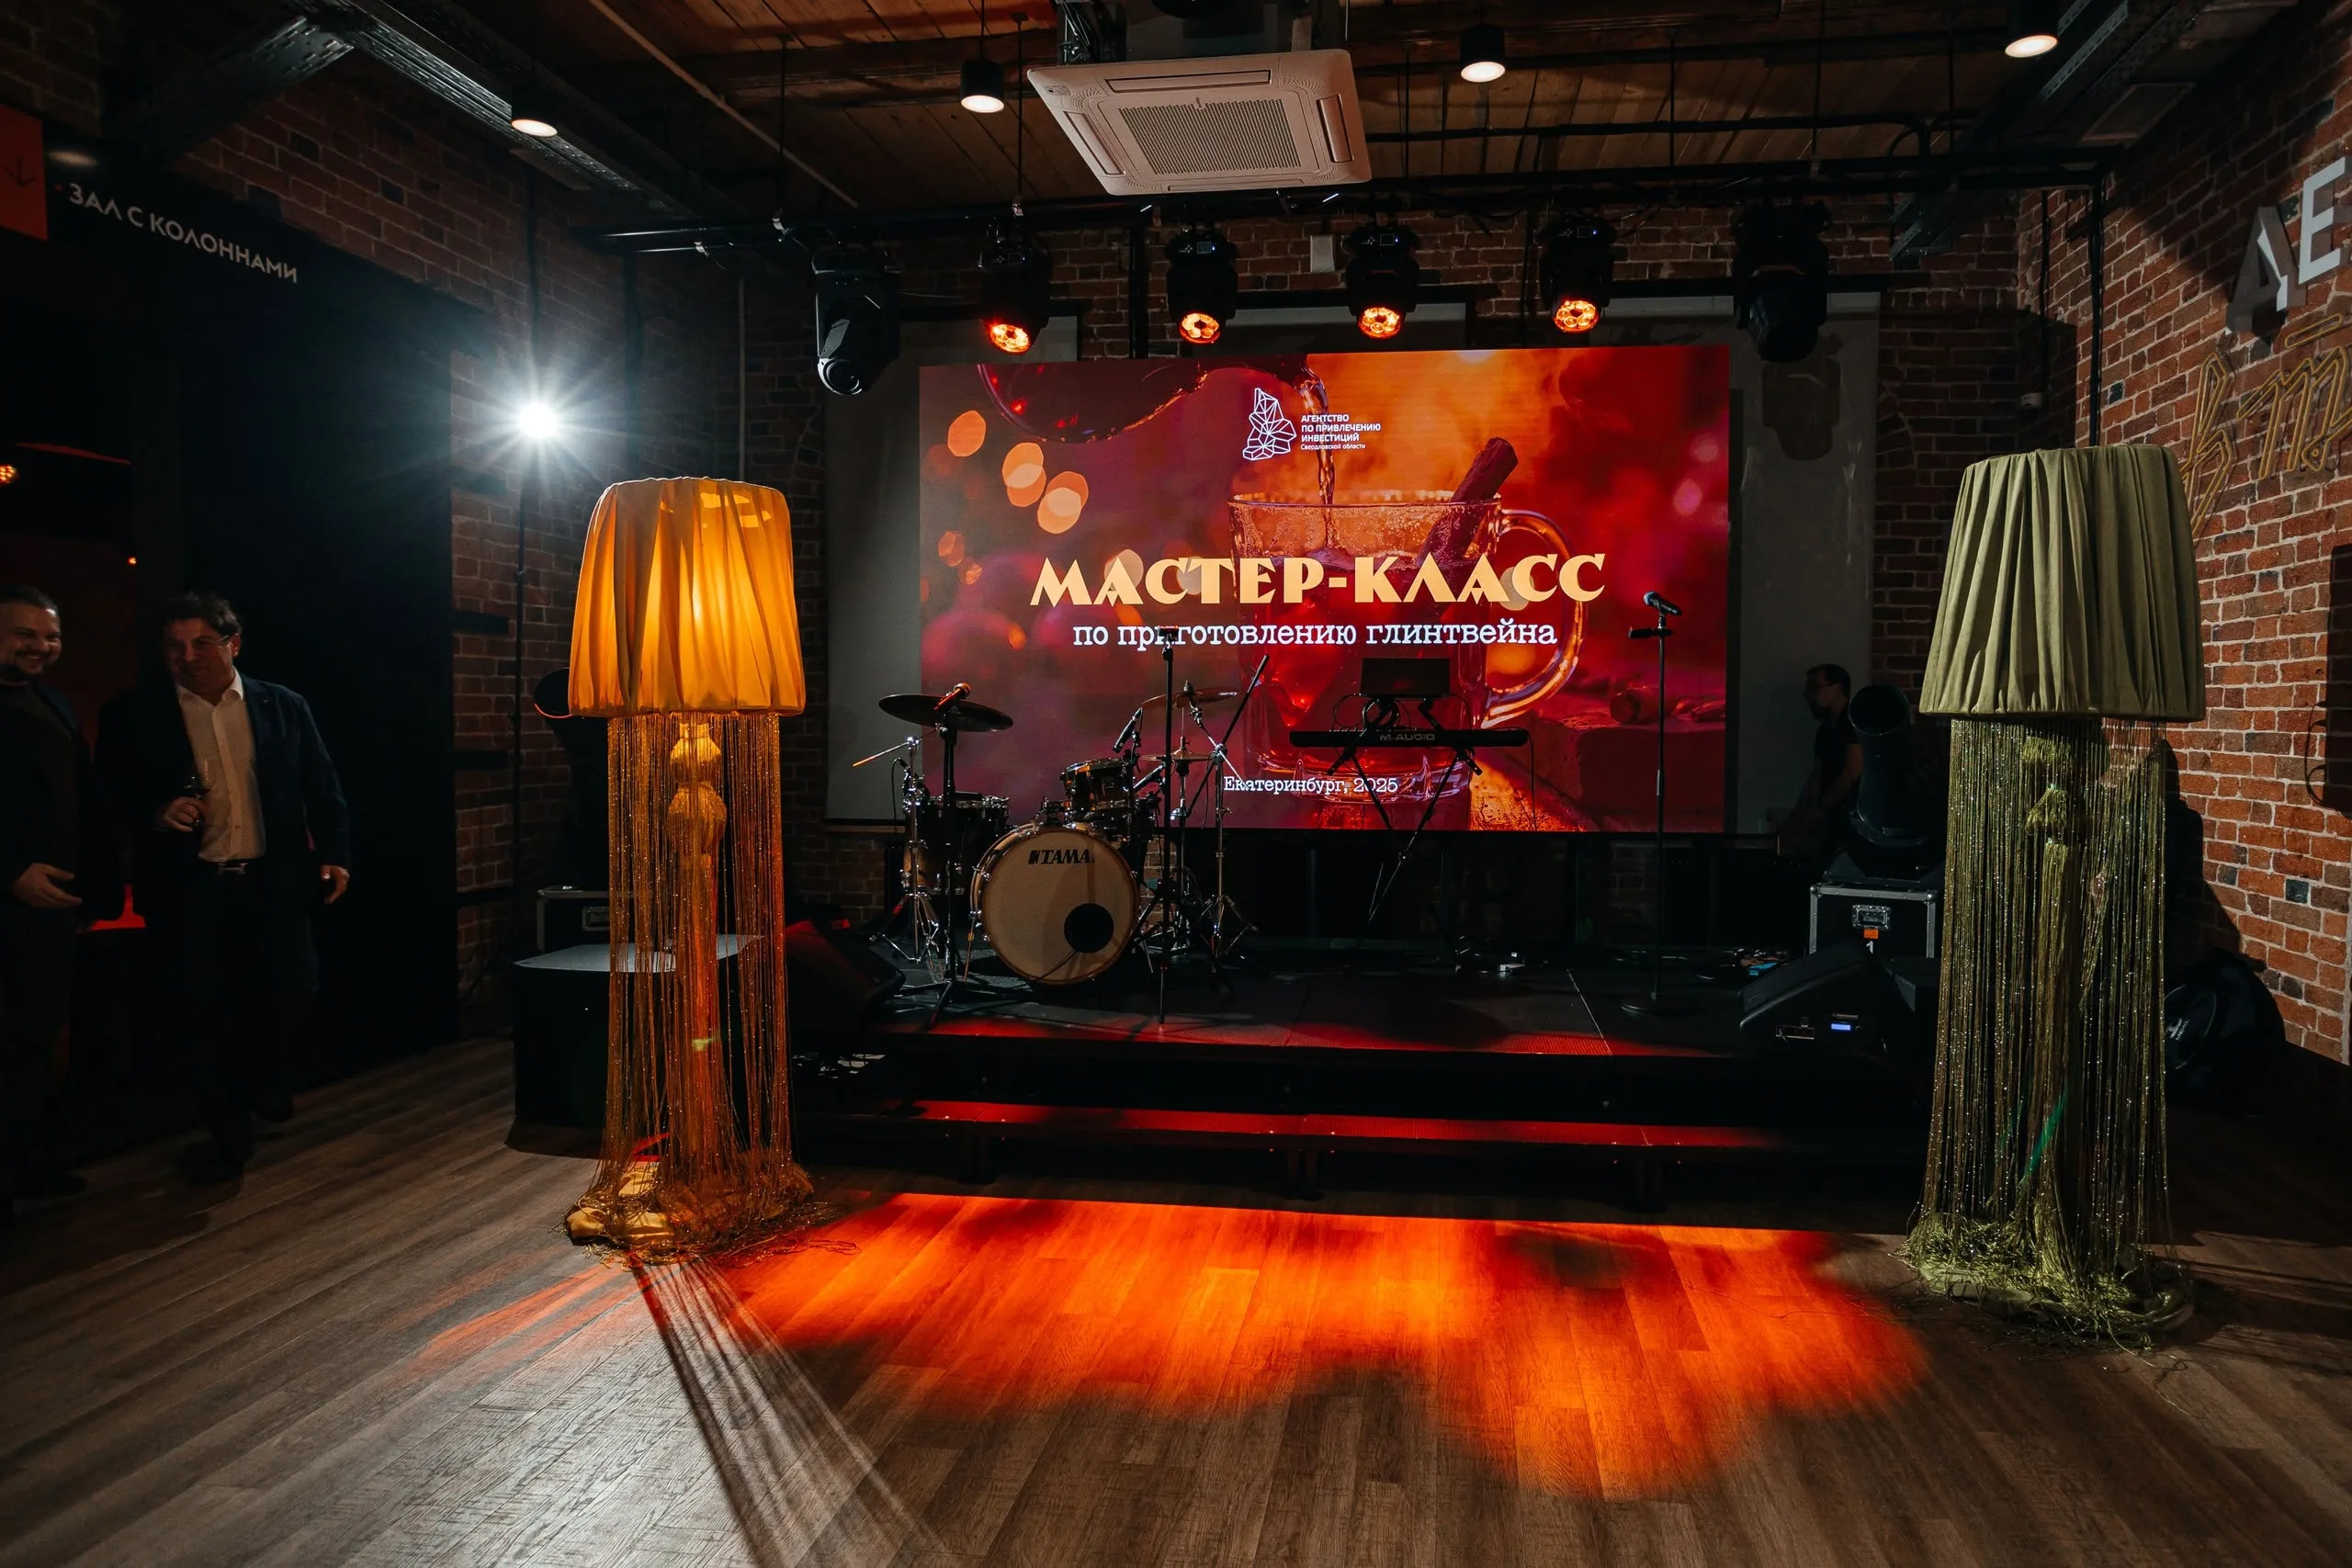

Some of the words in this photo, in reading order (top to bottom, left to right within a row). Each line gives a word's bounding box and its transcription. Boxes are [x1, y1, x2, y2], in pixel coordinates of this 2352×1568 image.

[68, 182, 123, 220] ЗАЛ
[126, 205, 144, 228] С
[149, 212, 299, 284] КОЛОННАМИ
[2225, 155, 2352, 335] ДЕ
[1301, 414, 1350, 423] АГЕНТСТВО
[1301, 424, 1314, 433] ПО
[1316, 423, 1382, 433] ПРИВЛЕЧЕНИЮ
[1301, 433, 1360, 443] ИНВЕСТИЦИЙ
[1029, 553, 1606, 607] МАСТЕР-КЛАСС
[1073, 626, 1109, 646] по
[1365, 619, 1557, 646] глинтвейна
[1379, 733, 1436, 741] M-AUDIO
[1224, 775, 1348, 795] Екатеринбург,
[1353, 777, 1399, 793] 2025
[1040, 849, 1091, 865] TAMA
